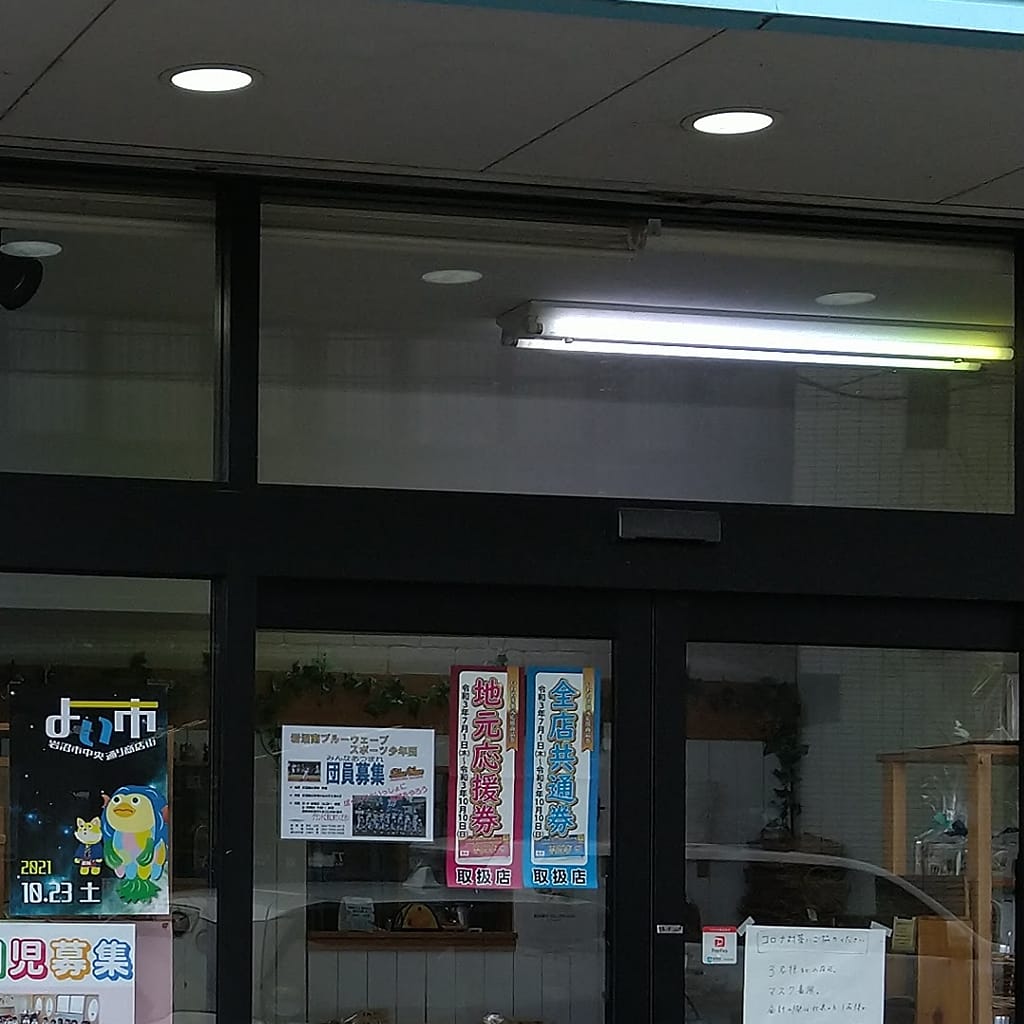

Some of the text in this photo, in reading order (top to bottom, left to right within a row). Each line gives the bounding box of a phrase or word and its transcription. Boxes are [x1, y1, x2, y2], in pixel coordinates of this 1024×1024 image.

[472, 677, 504, 837] 地元応援券
[547, 679, 582, 837] 全店共通券
[326, 762, 385, 785] 団員募集
[20, 860, 53, 875] 2021
[456, 868, 512, 885] 取扱店
[532, 868, 588, 885] 取扱店
[21, 882, 101, 904] 10.23 土
